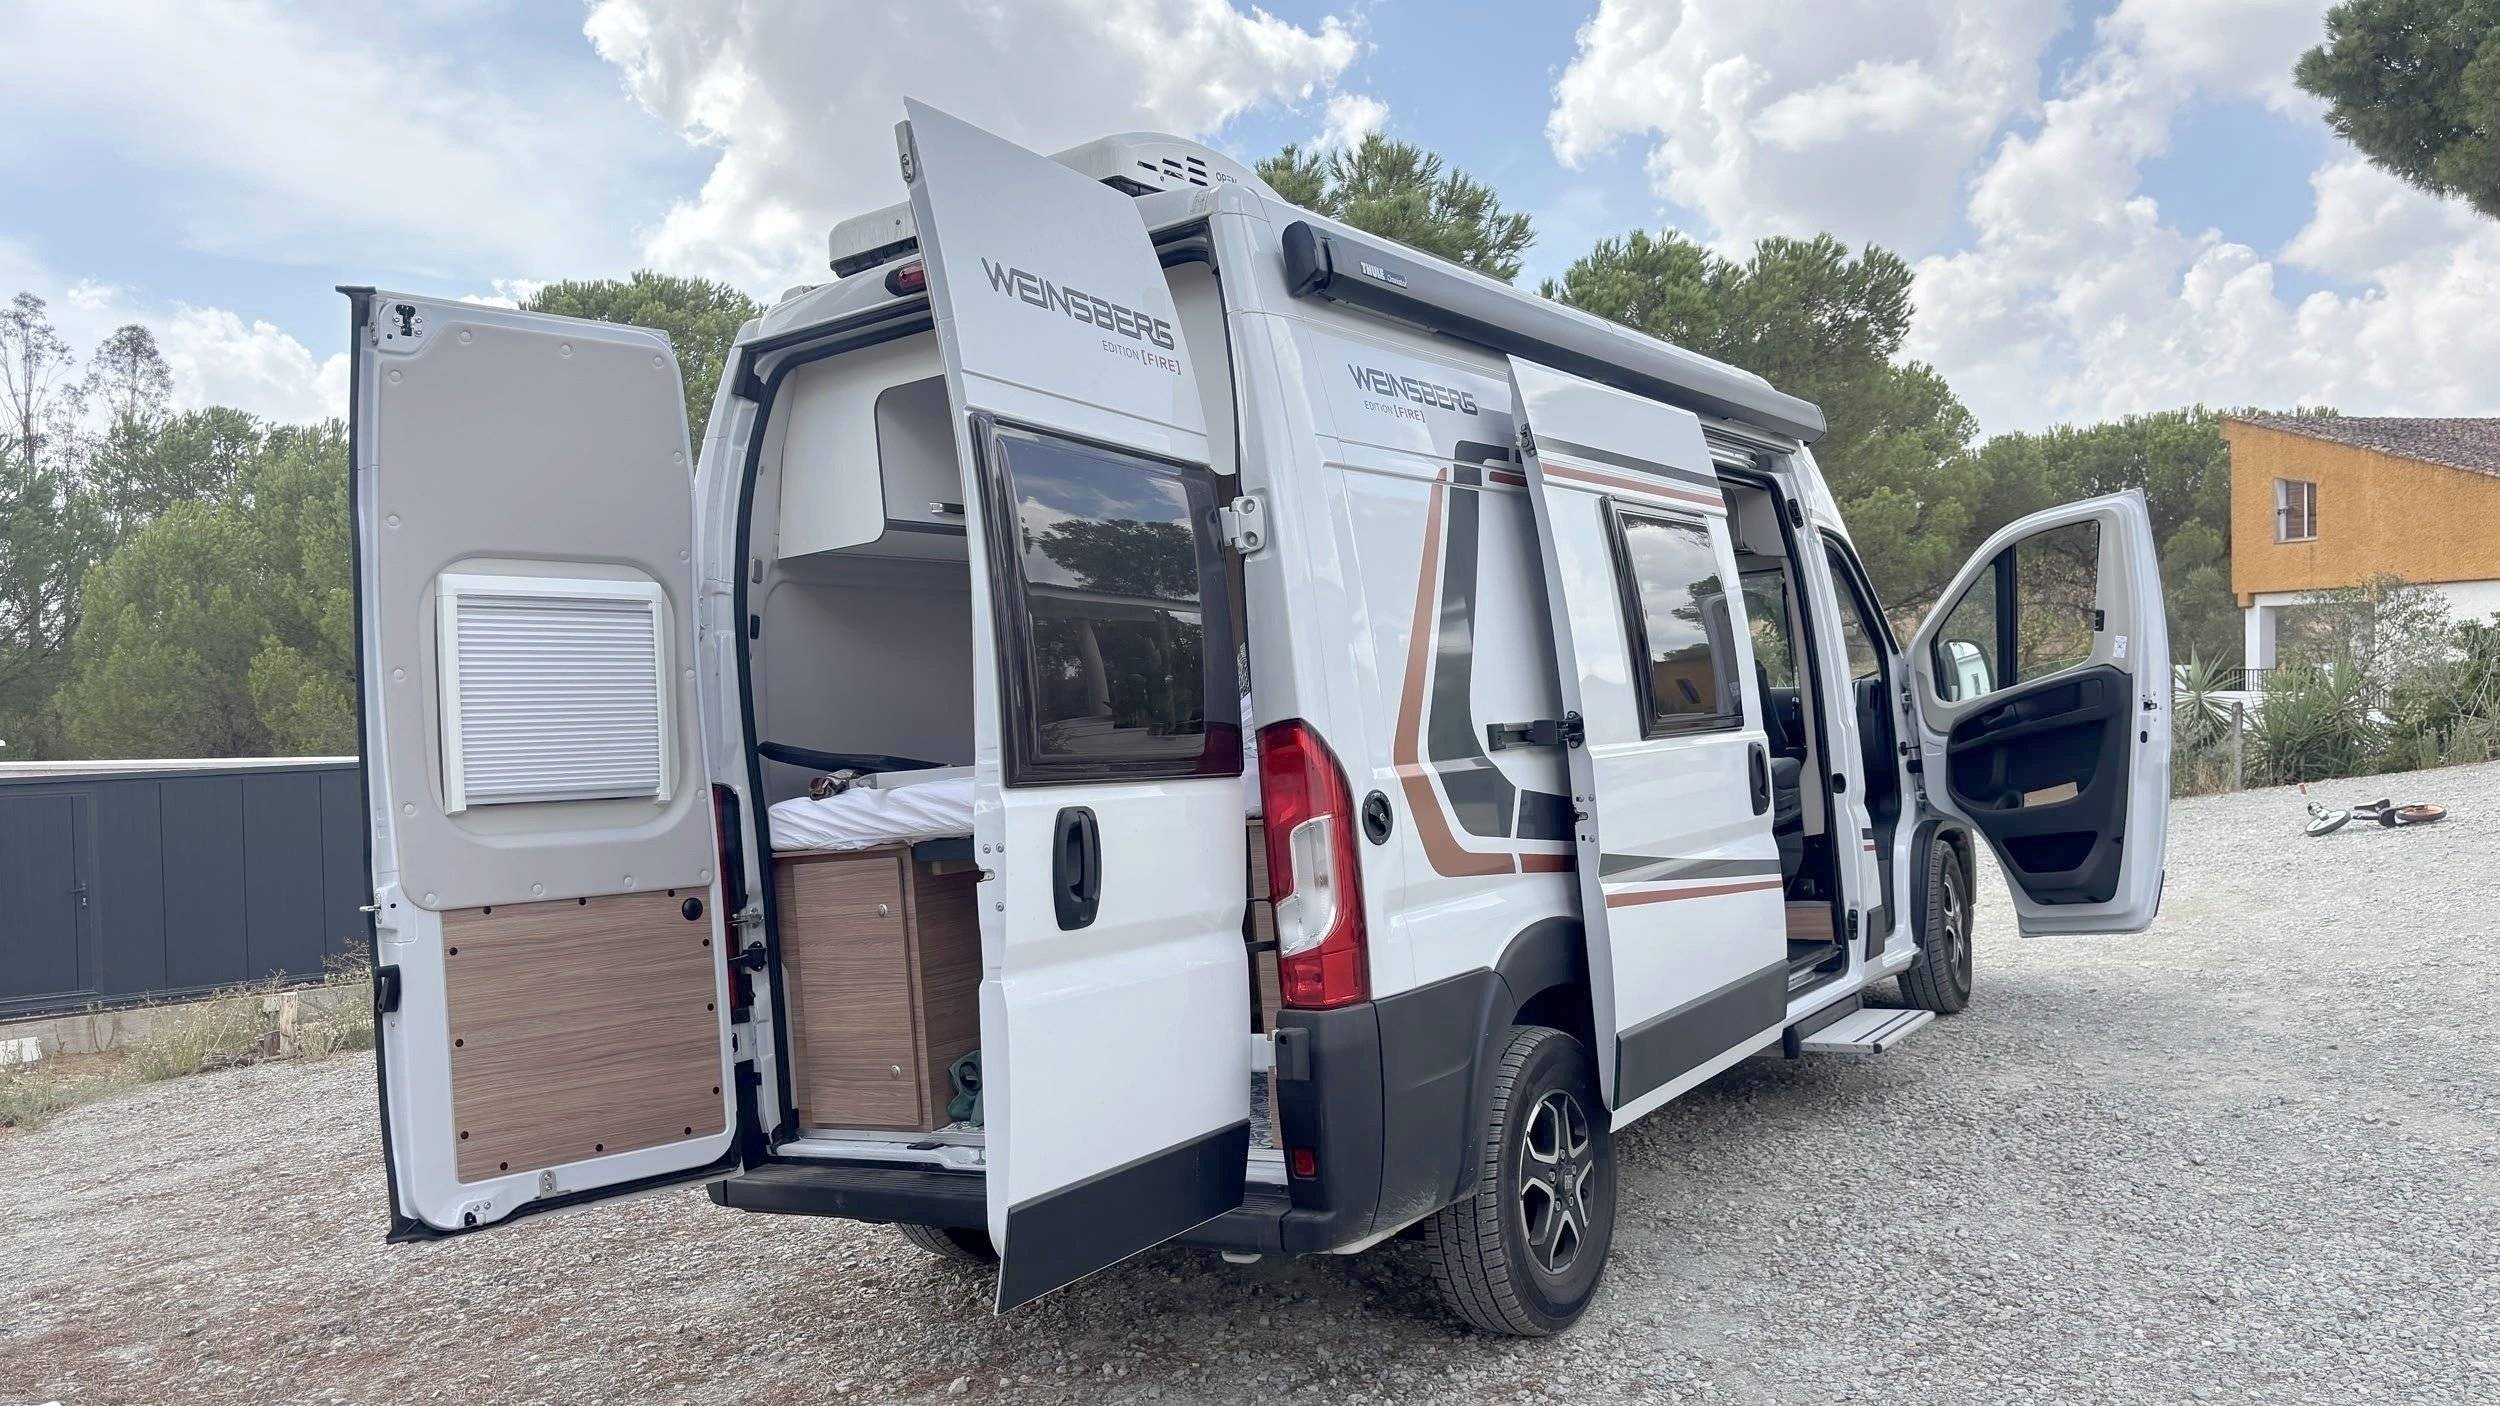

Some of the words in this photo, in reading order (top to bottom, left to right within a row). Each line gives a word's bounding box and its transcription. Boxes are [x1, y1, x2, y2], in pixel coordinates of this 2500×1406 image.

[1360, 261, 1386, 281] THULE
[981, 257, 1175, 351] WEINSBERG
[1102, 340, 1140, 361] EDITION
[1141, 350, 1182, 376] [FIRE]
[1347, 363, 1479, 416] WEINSBERG
[1364, 400, 1393, 414] EDITION
[1394, 404, 1426, 423] [FIRE]
